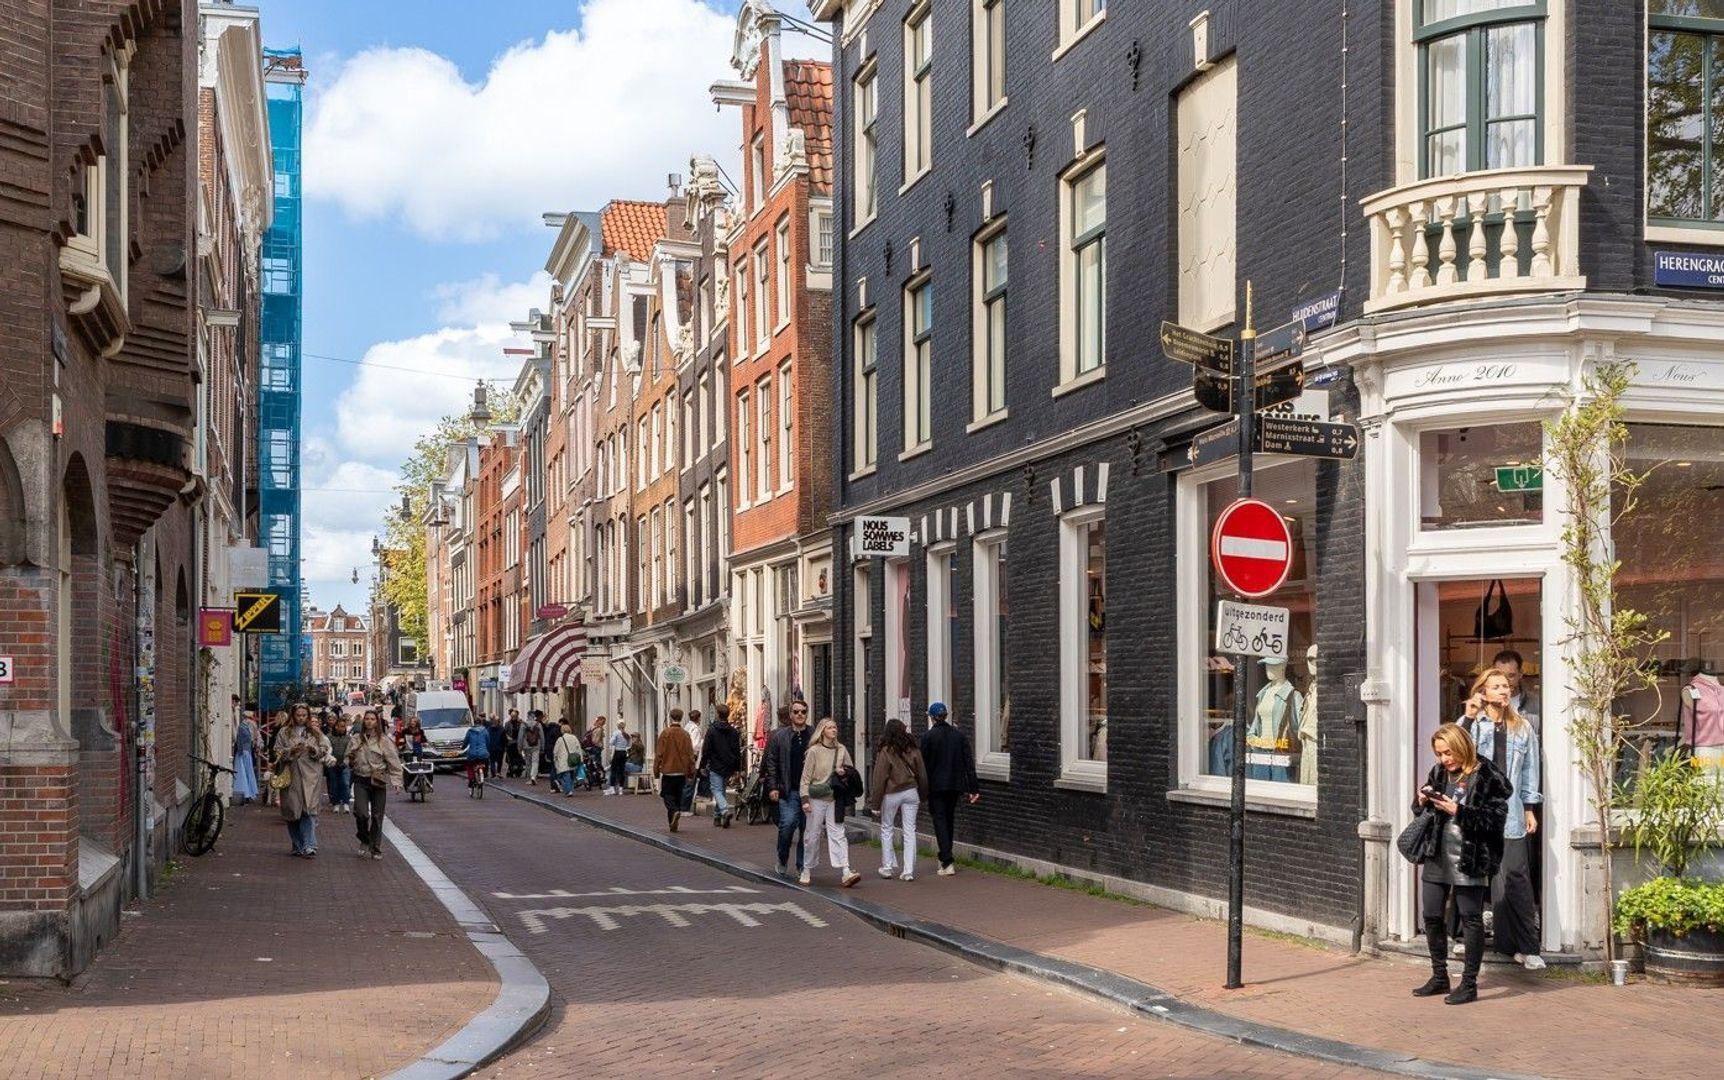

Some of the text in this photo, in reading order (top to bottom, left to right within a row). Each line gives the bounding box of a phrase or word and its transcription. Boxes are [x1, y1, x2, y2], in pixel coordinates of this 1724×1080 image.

[1293, 295, 1337, 322] HUIDENSTRAAT
[1415, 363, 1517, 388] Anno 2010
[1265, 421, 1310, 433] Westerkerk
[1265, 431, 1315, 444] Marnixstraat
[1265, 440, 1282, 449] Dam
[863, 520, 888, 530] NOUS
[863, 530, 904, 542] SOMMES
[863, 541, 894, 551] LABELS
[235, 595, 273, 631] ZIPPER
[1225, 606, 1285, 623] uitgezonderd
